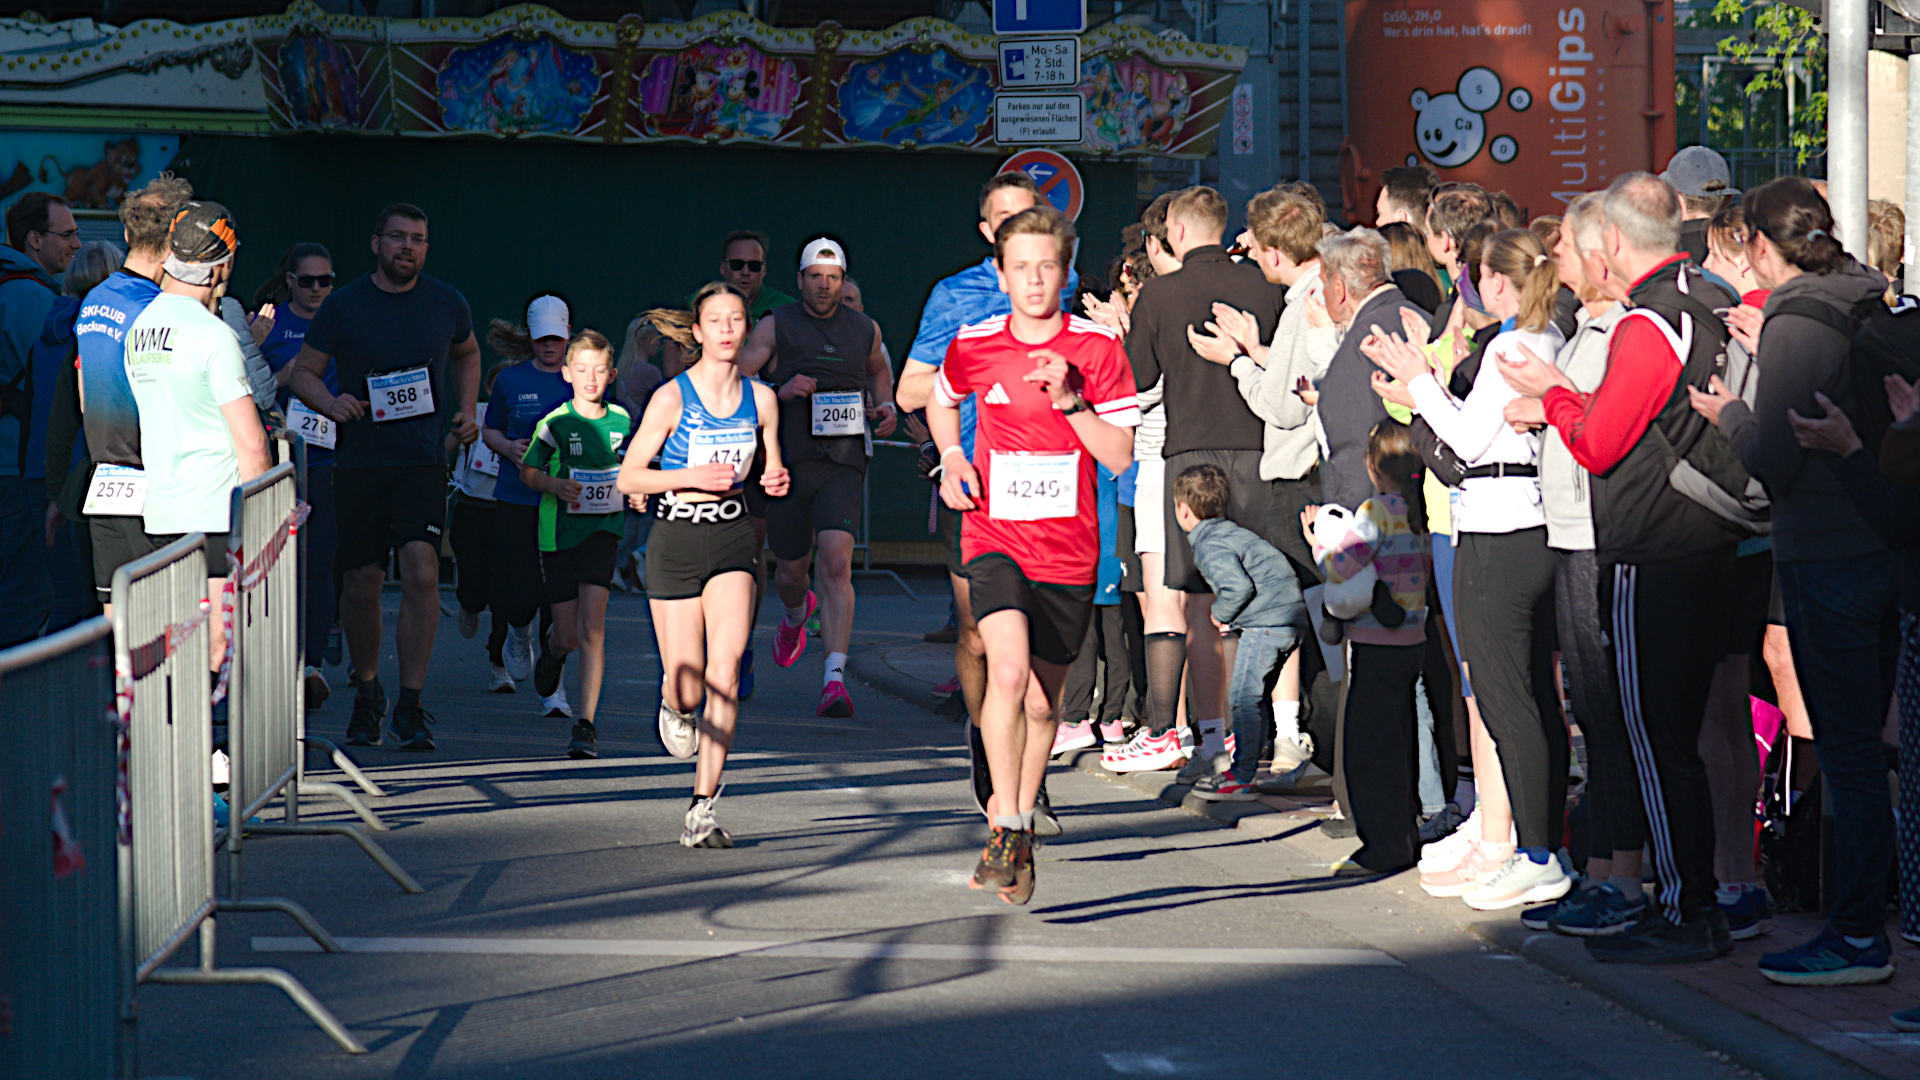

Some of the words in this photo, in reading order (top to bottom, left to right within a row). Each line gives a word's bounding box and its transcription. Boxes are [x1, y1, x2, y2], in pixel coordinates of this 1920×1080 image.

[1412, 25, 1433, 37] drin
[1436, 25, 1459, 38] hat,
[1493, 23, 1532, 36] drauf!
[1031, 45, 1047, 55] Mo
[1055, 44, 1068, 54] Sa
[1034, 58, 1040, 68] 2
[1044, 57, 1065, 68] Std.
[1058, 70, 1065, 80] h
[1007, 102, 1031, 110] Parken
[1045, 101, 1056, 110] auf
[1057, 101, 1070, 110] den
[1000, 115, 1050, 124] ausgewiesenen
[1051, 113, 1077, 122] Flächen
[1455, 118, 1472, 130] Ca
[1019, 126, 1030, 135] (P)
[80, 304, 126, 324] SKI-CLUB
[76, 320, 107, 335] Beckum
[107, 327, 122, 342] e.V.
[134, 327, 172, 352] WML
[386, 386, 417, 406] 368
[822, 407, 856, 422] 2040
[301, 416, 328, 434] 276
[709, 448, 741, 464] 474
[95, 481, 135, 498] 2575
[585, 484, 613, 500] 367
[1007, 479, 1060, 498] 4249
[666, 499, 742, 523] PRO
